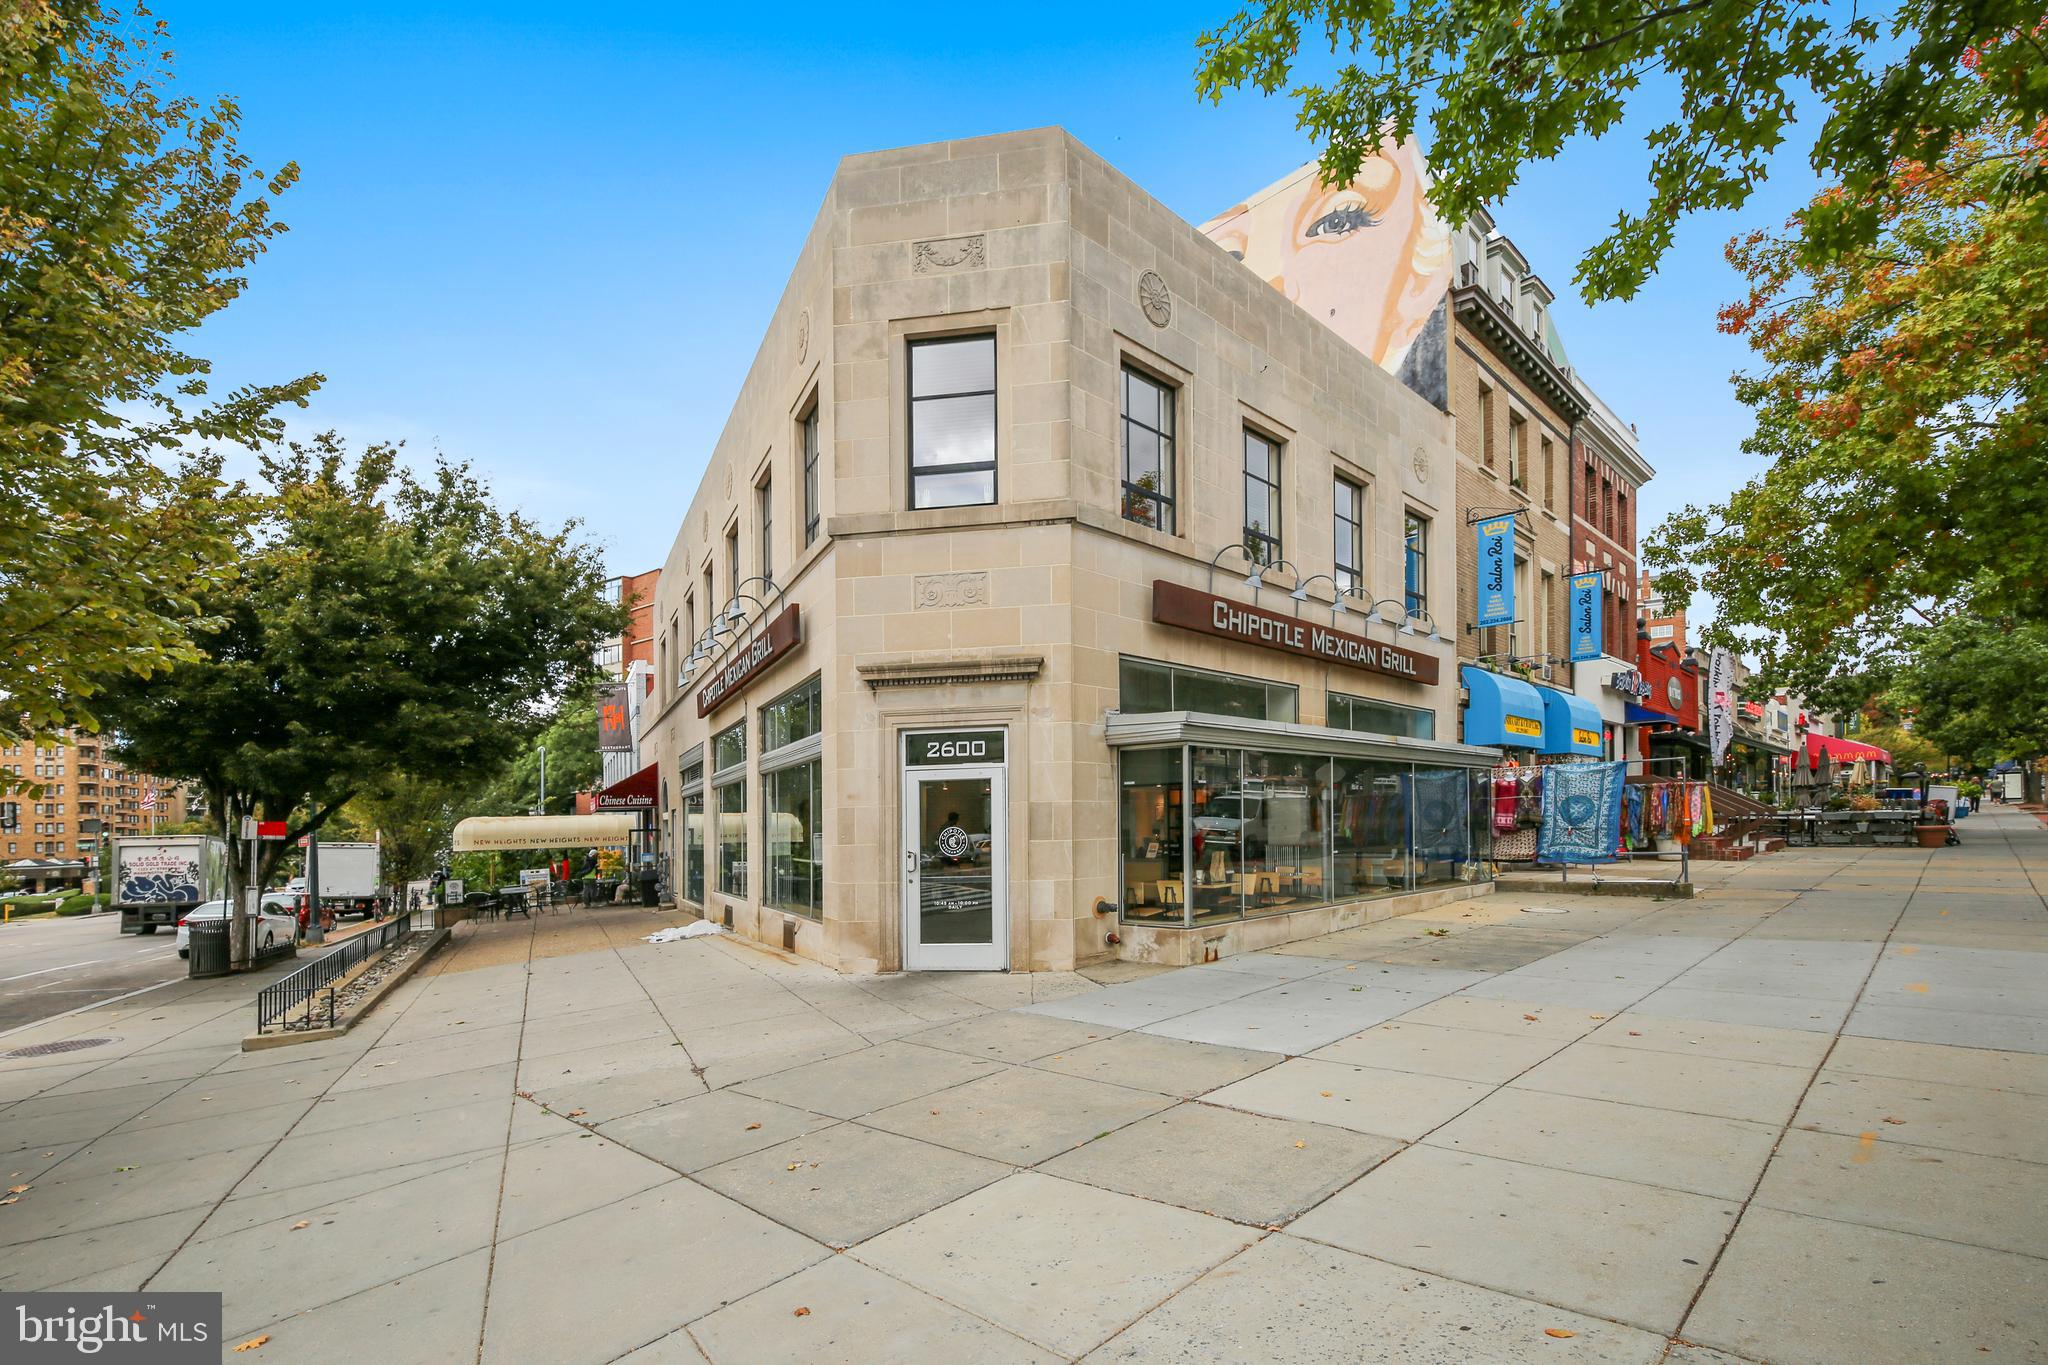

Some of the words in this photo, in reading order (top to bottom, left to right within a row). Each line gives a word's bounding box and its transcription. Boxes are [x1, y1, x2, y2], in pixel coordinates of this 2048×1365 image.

[1487, 535, 1503, 557] Roi
[1487, 557, 1503, 592] Salon
[1578, 588, 1592, 606] Roi
[1578, 605, 1592, 634] Salon
[1212, 600, 1305, 649] CHIPOTLE
[1311, 627, 1377, 666] MEXICAN
[1381, 646, 1417, 675] GRILL
[702, 675, 725, 709] CHIPOTLE
[724, 651, 751, 690] MEXICAN
[751, 632, 773, 667] GRILL
[926, 740, 986, 758] 2600
[599, 795, 626, 806] Chinese
[627, 794, 653, 805] Cuisine
[549, 836, 581, 844] HEIGHTS
